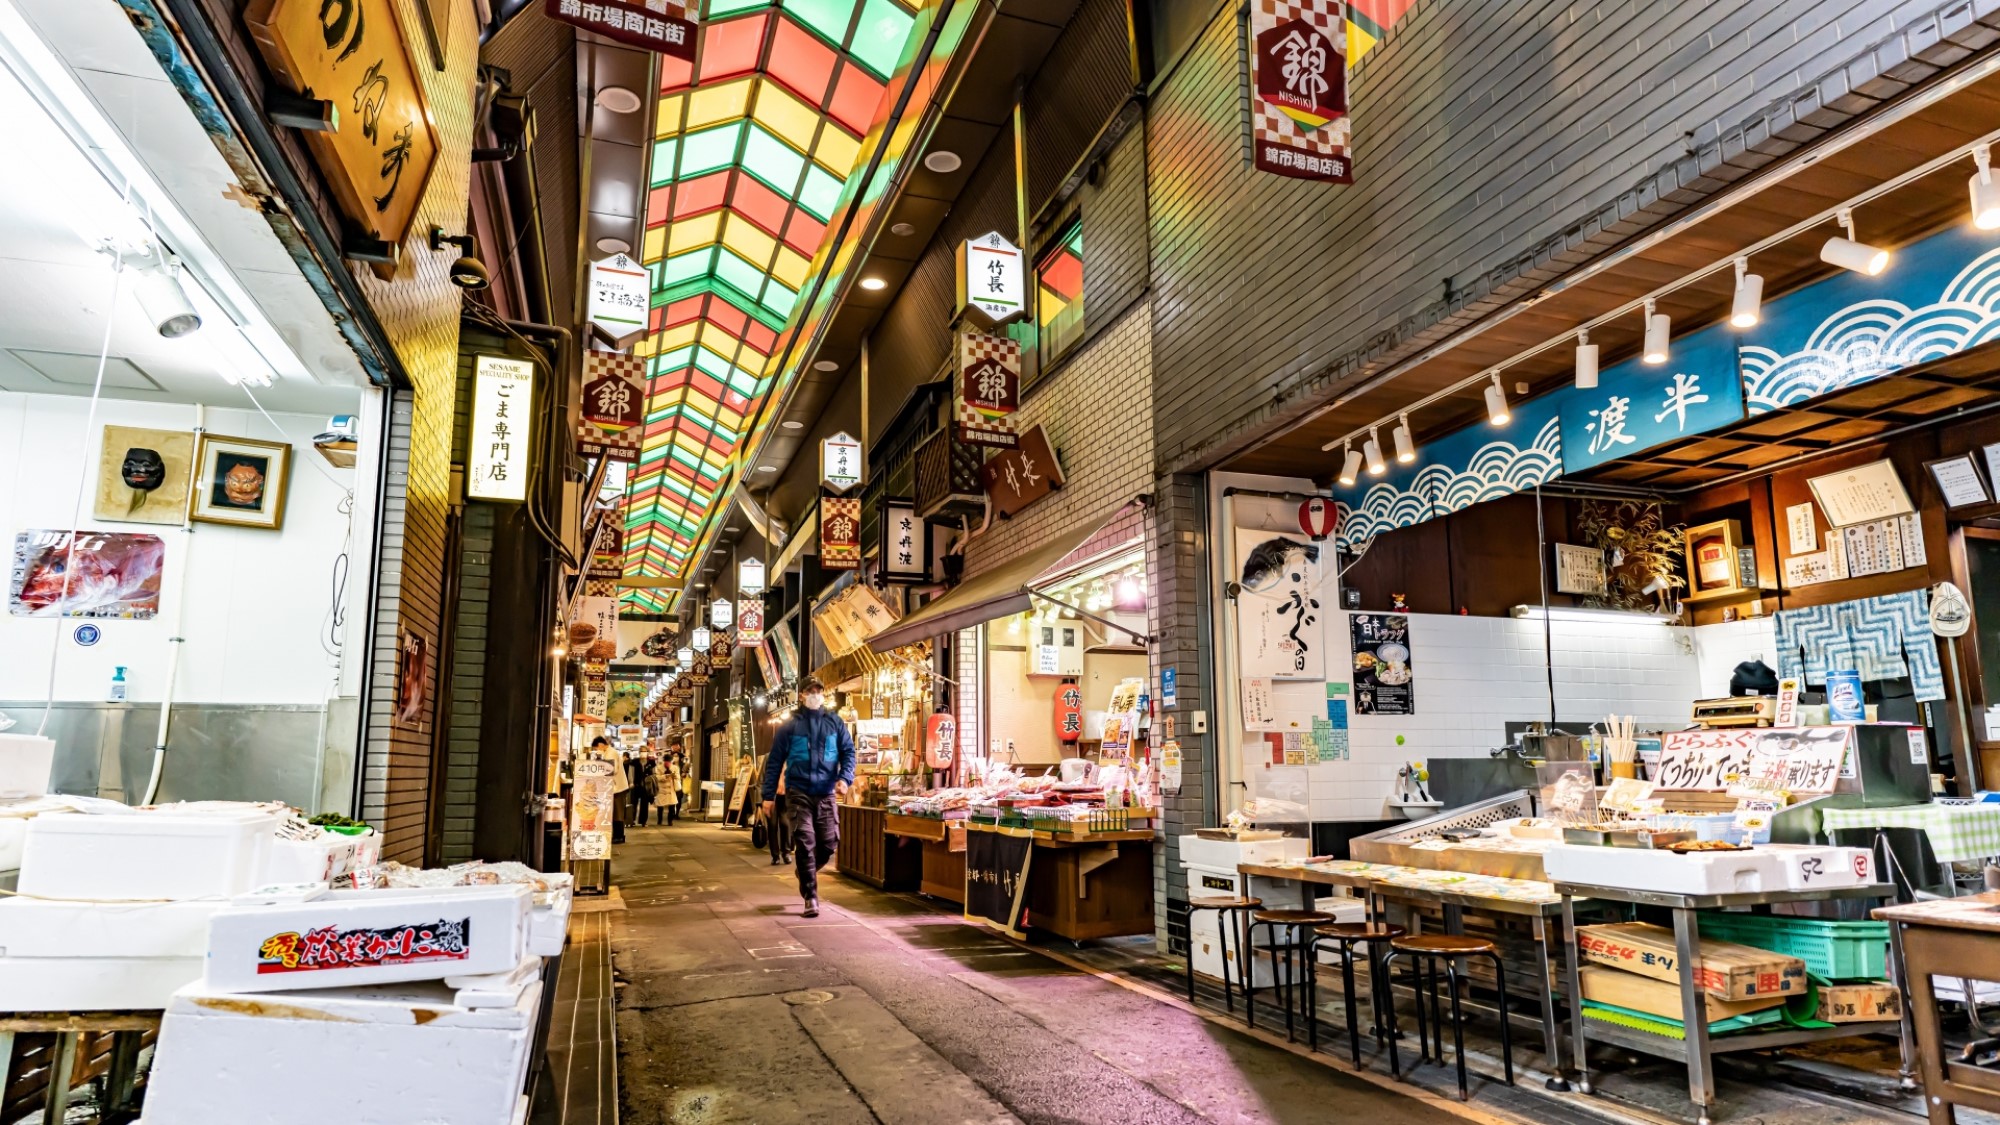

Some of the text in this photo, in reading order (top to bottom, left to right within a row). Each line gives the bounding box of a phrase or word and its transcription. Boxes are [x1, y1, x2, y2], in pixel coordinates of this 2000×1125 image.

[559, 0, 686, 46] 錦市場商店街
[1270, 29, 1330, 113] 錦
[1278, 90, 1312, 109] NISHIKI
[1265, 146, 1345, 177] 錦市場商店街
[986, 258, 1005, 293] 竹長
[479, 369, 530, 382] SPECIALITY SHOP
[488, 362, 521, 373] SESAME
[591, 380, 631, 424] 錦
[971, 364, 1008, 411] 錦
[593, 413, 617, 423] NISHIKI
[975, 398, 998, 409] NISHIKI
[1584, 373, 1710, 456] 渡半
[487, 383, 515, 481] ごま専門店
[965, 428, 1016, 446] 錦市場商店街
[582, 444, 636, 459] 錦市商店街
[828, 516, 853, 545] 錦
[899, 517, 913, 565] 京丹波
[1062, 689, 1080, 732] 竹長
[937, 722, 955, 760] 竹長
[1667, 730, 1757, 751] とらふぐ
[578, 764, 605, 774] 410円
[300, 927, 435, 965] 松葉がに
[1642, 951, 1680, 972] んま
